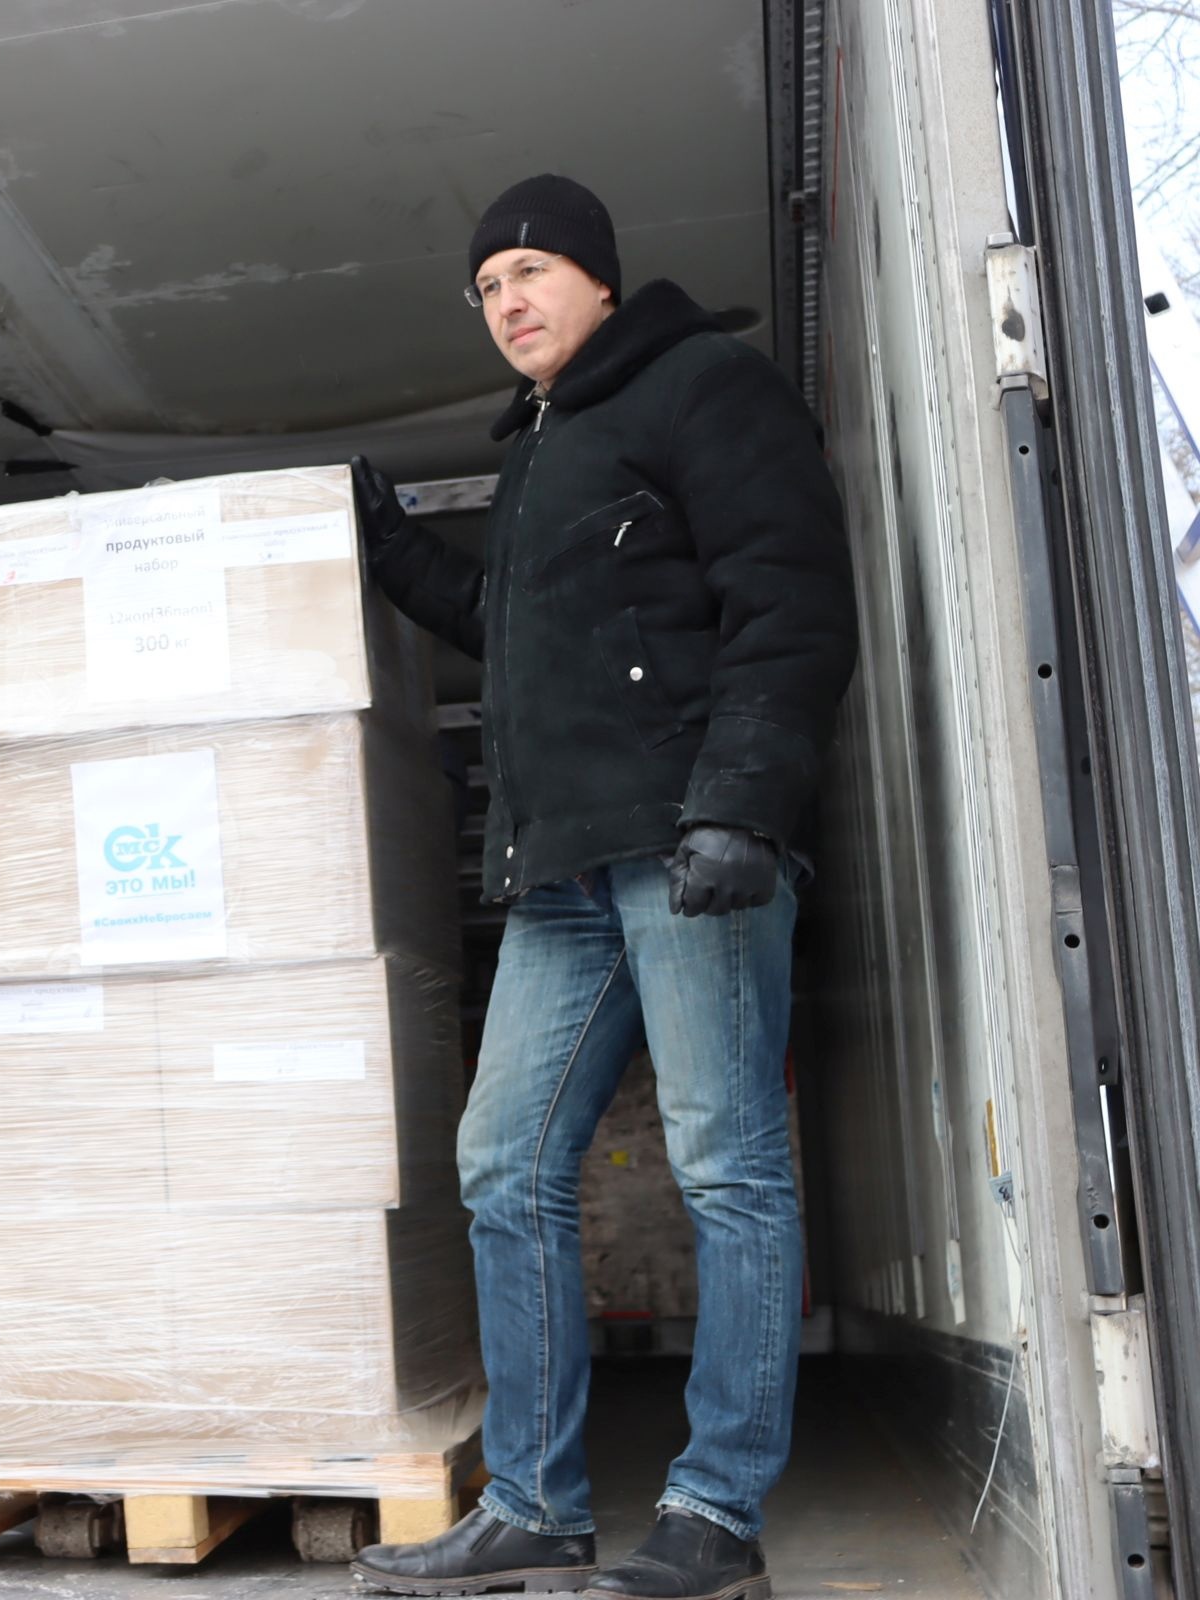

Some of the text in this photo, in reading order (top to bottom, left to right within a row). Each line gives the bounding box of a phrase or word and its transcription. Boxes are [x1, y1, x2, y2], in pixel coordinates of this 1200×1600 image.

[105, 529, 205, 553] продуктовый
[134, 557, 179, 574] набор
[134, 633, 191, 654] 300 кг
[105, 869, 197, 896] ЭТО МЫ!
